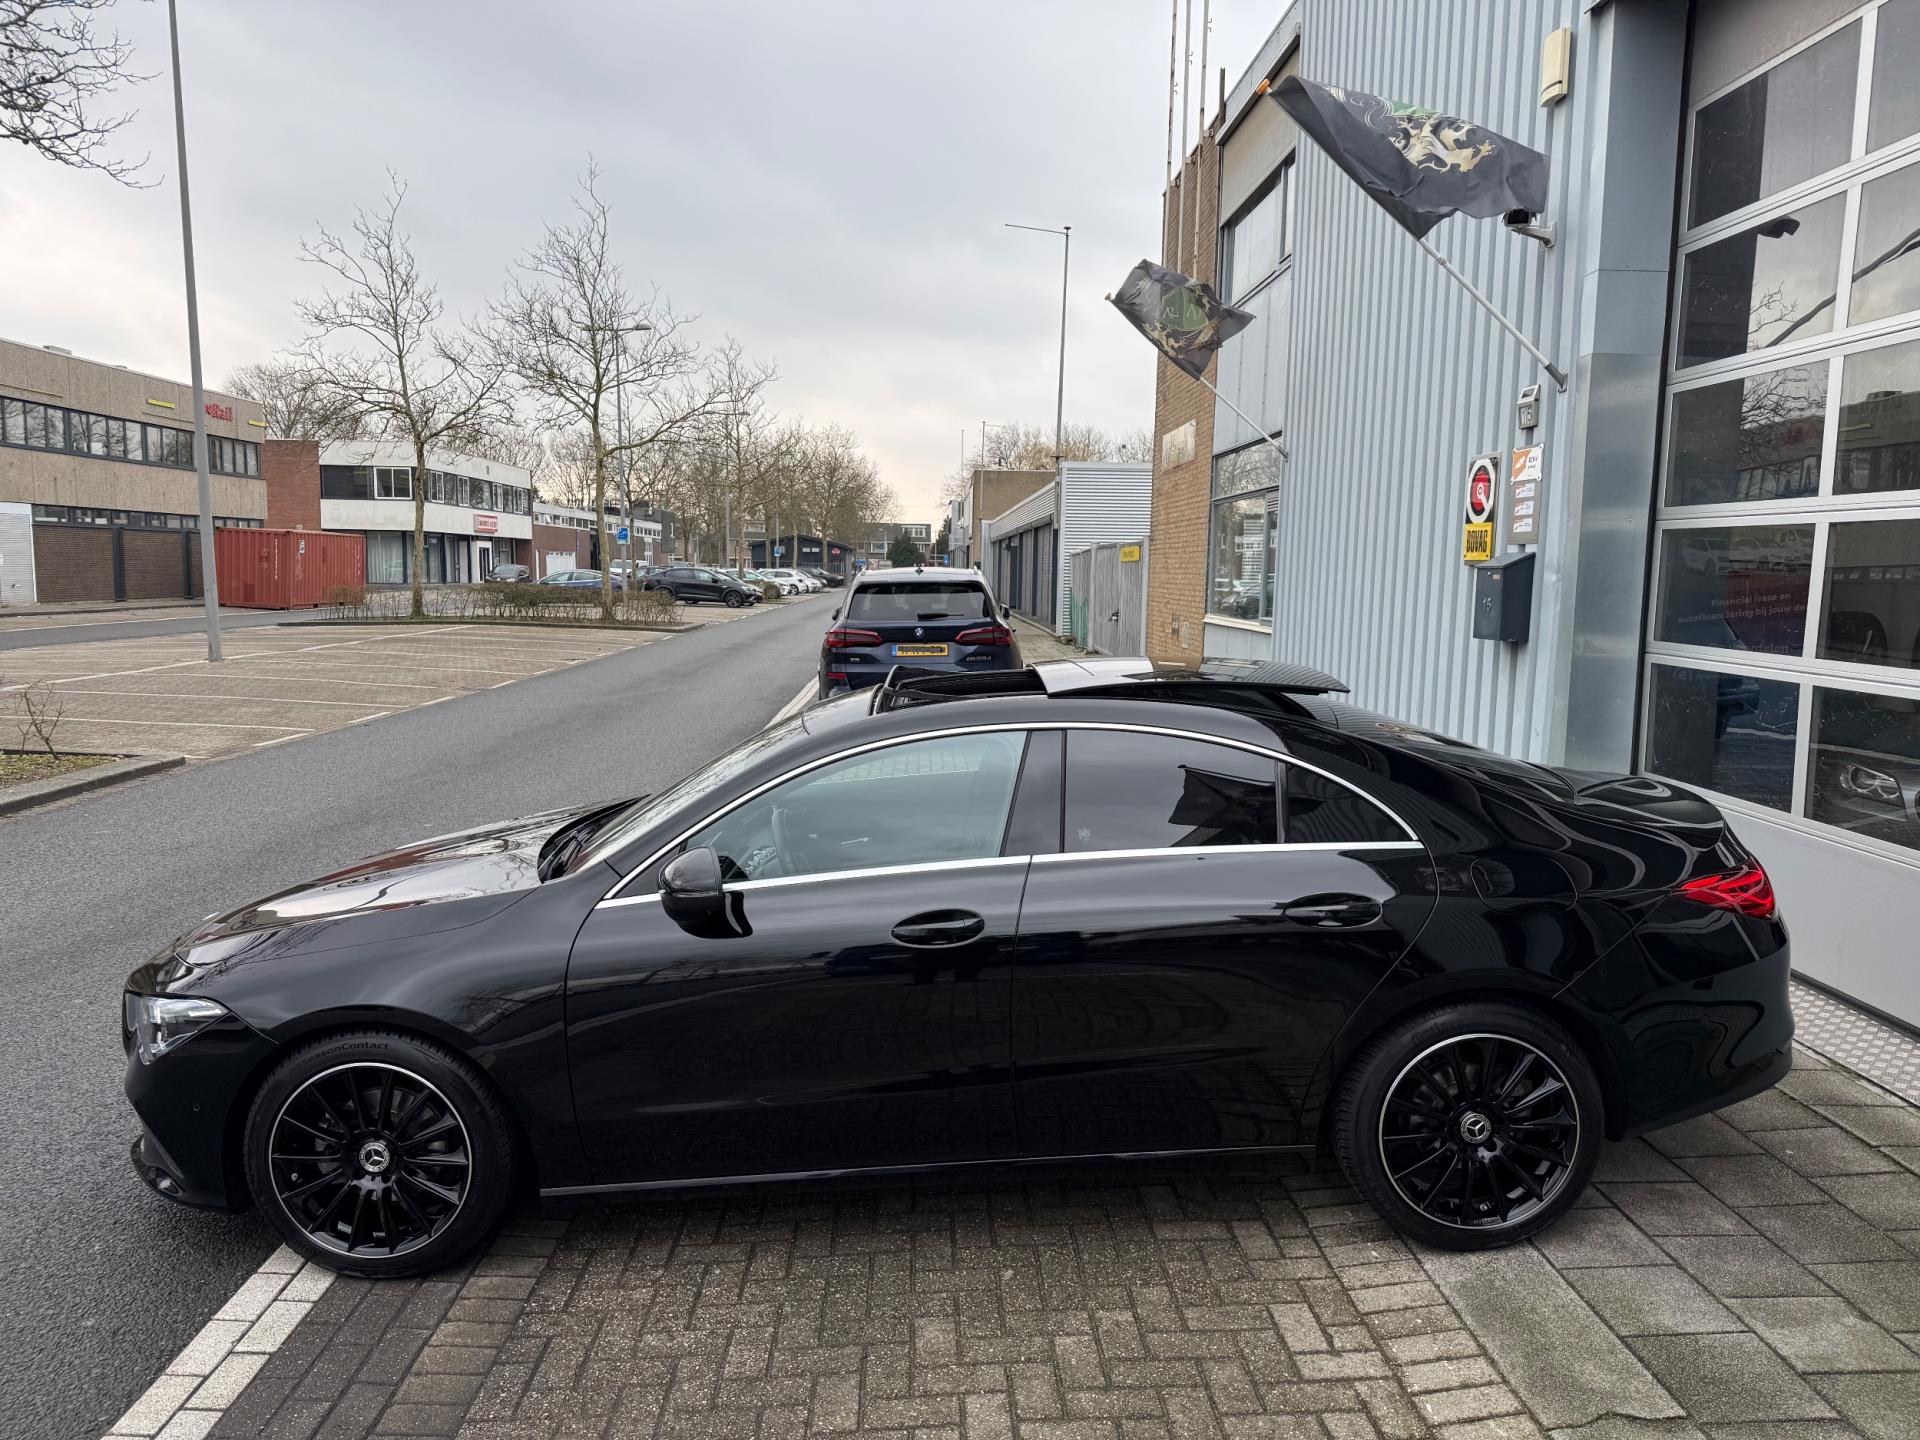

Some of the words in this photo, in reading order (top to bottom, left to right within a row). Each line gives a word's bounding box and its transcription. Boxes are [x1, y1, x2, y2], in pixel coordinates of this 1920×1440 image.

[1521, 407, 1533, 425] 15
[1467, 529, 1488, 553] BOVAG
[1483, 597, 1492, 611] 15
[1711, 595, 1752, 607] Financial
[1754, 594, 1777, 603] lease
[1678, 608, 1753, 623] autofinanciering
[1755, 606, 1767, 617] bij
[1768, 605, 1792, 616] jouw
